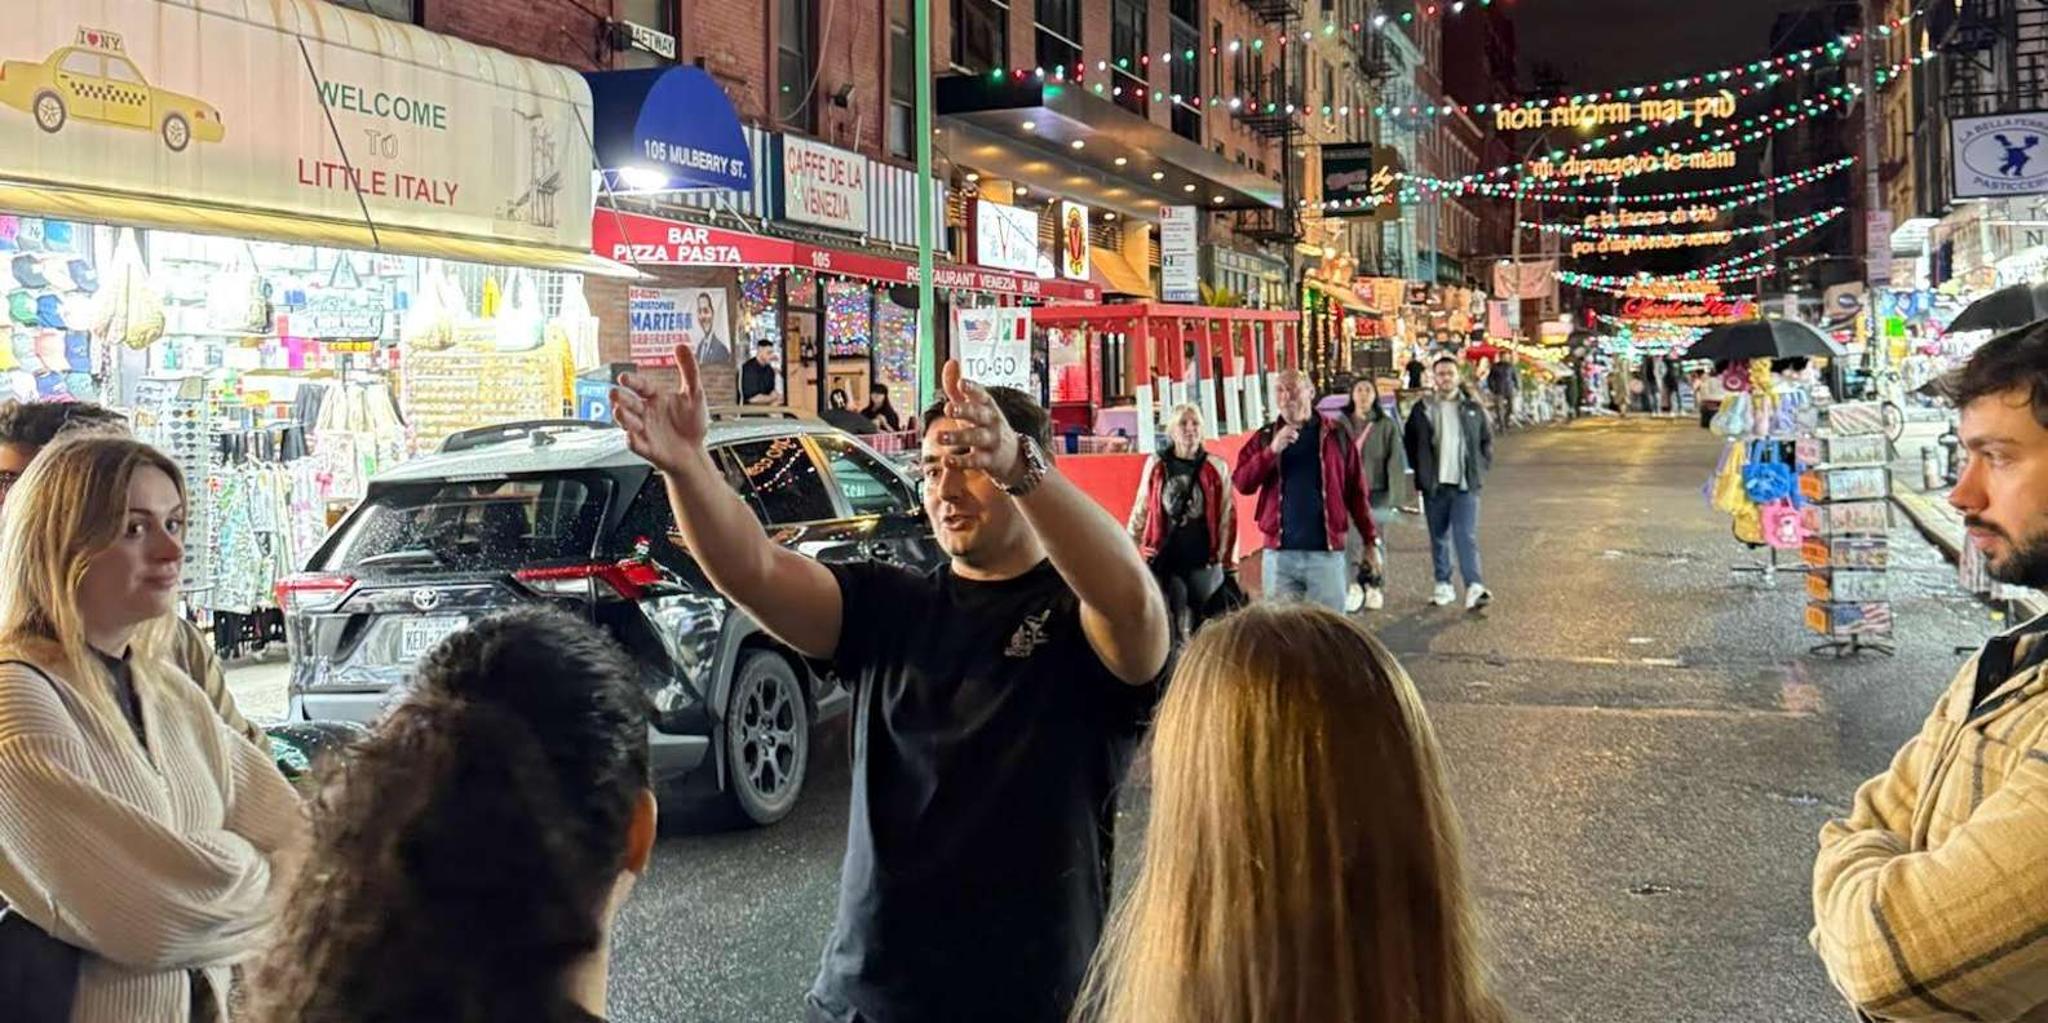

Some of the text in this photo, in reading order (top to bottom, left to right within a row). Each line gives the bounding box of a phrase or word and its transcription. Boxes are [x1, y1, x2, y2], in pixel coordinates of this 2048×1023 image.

[100, 34, 121, 51] NY
[319, 81, 447, 130] WELCOME
[1496, 105, 1543, 131] non
[1549, 97, 1632, 127] ritorni
[364, 129, 399, 160] TO
[643, 138, 747, 179] 105 MULBERRY ST.
[298, 158, 459, 207] LITTLE ITALY
[786, 145, 864, 192] CAFFE DE LA
[801, 184, 853, 221] VENEZIA
[667, 227, 709, 245] BAR
[613, 244, 742, 263] PIZZA PASTA
[810, 250, 832, 269] 105
[906, 264, 1042, 295] RETAURANT VENEZIA BAR
